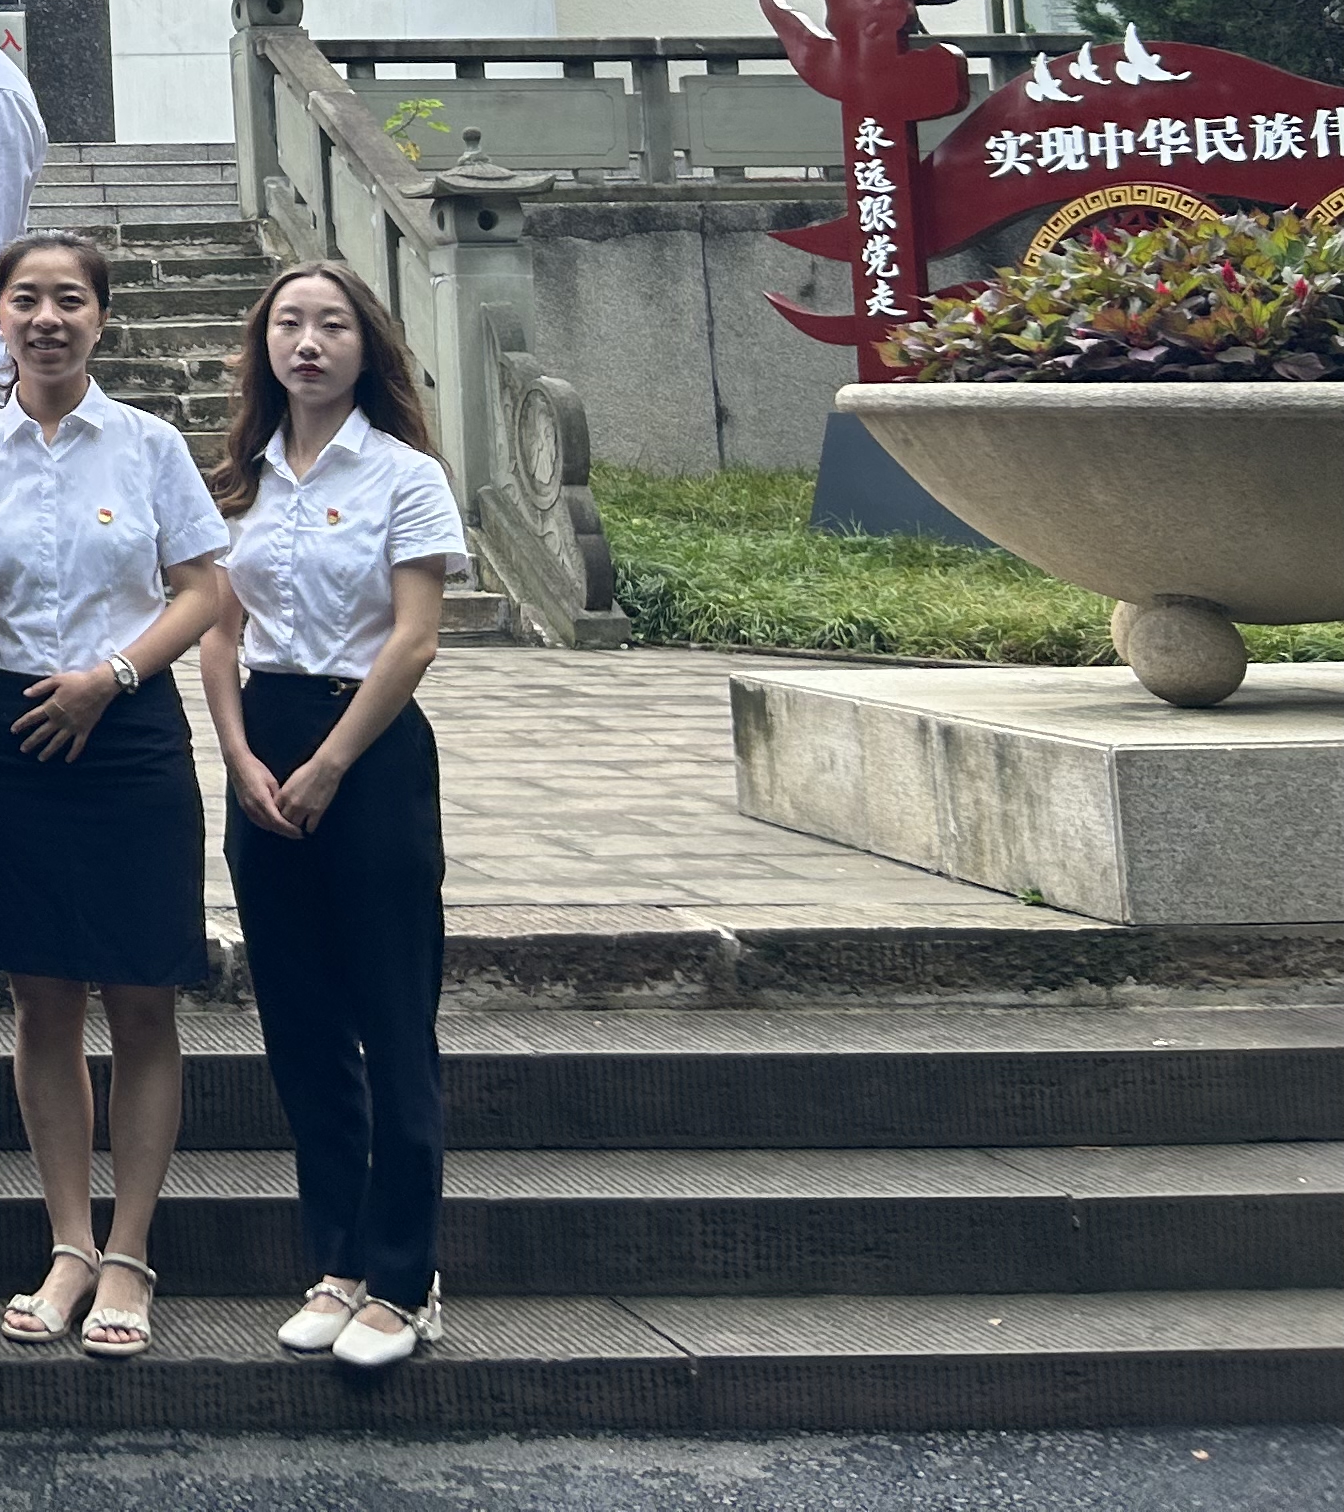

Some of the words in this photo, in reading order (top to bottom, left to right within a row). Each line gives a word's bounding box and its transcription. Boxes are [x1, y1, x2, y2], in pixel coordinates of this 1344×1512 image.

[983, 106, 1344, 178] 实现中华民族伟
[853, 117, 908, 317] 永远跟党走
